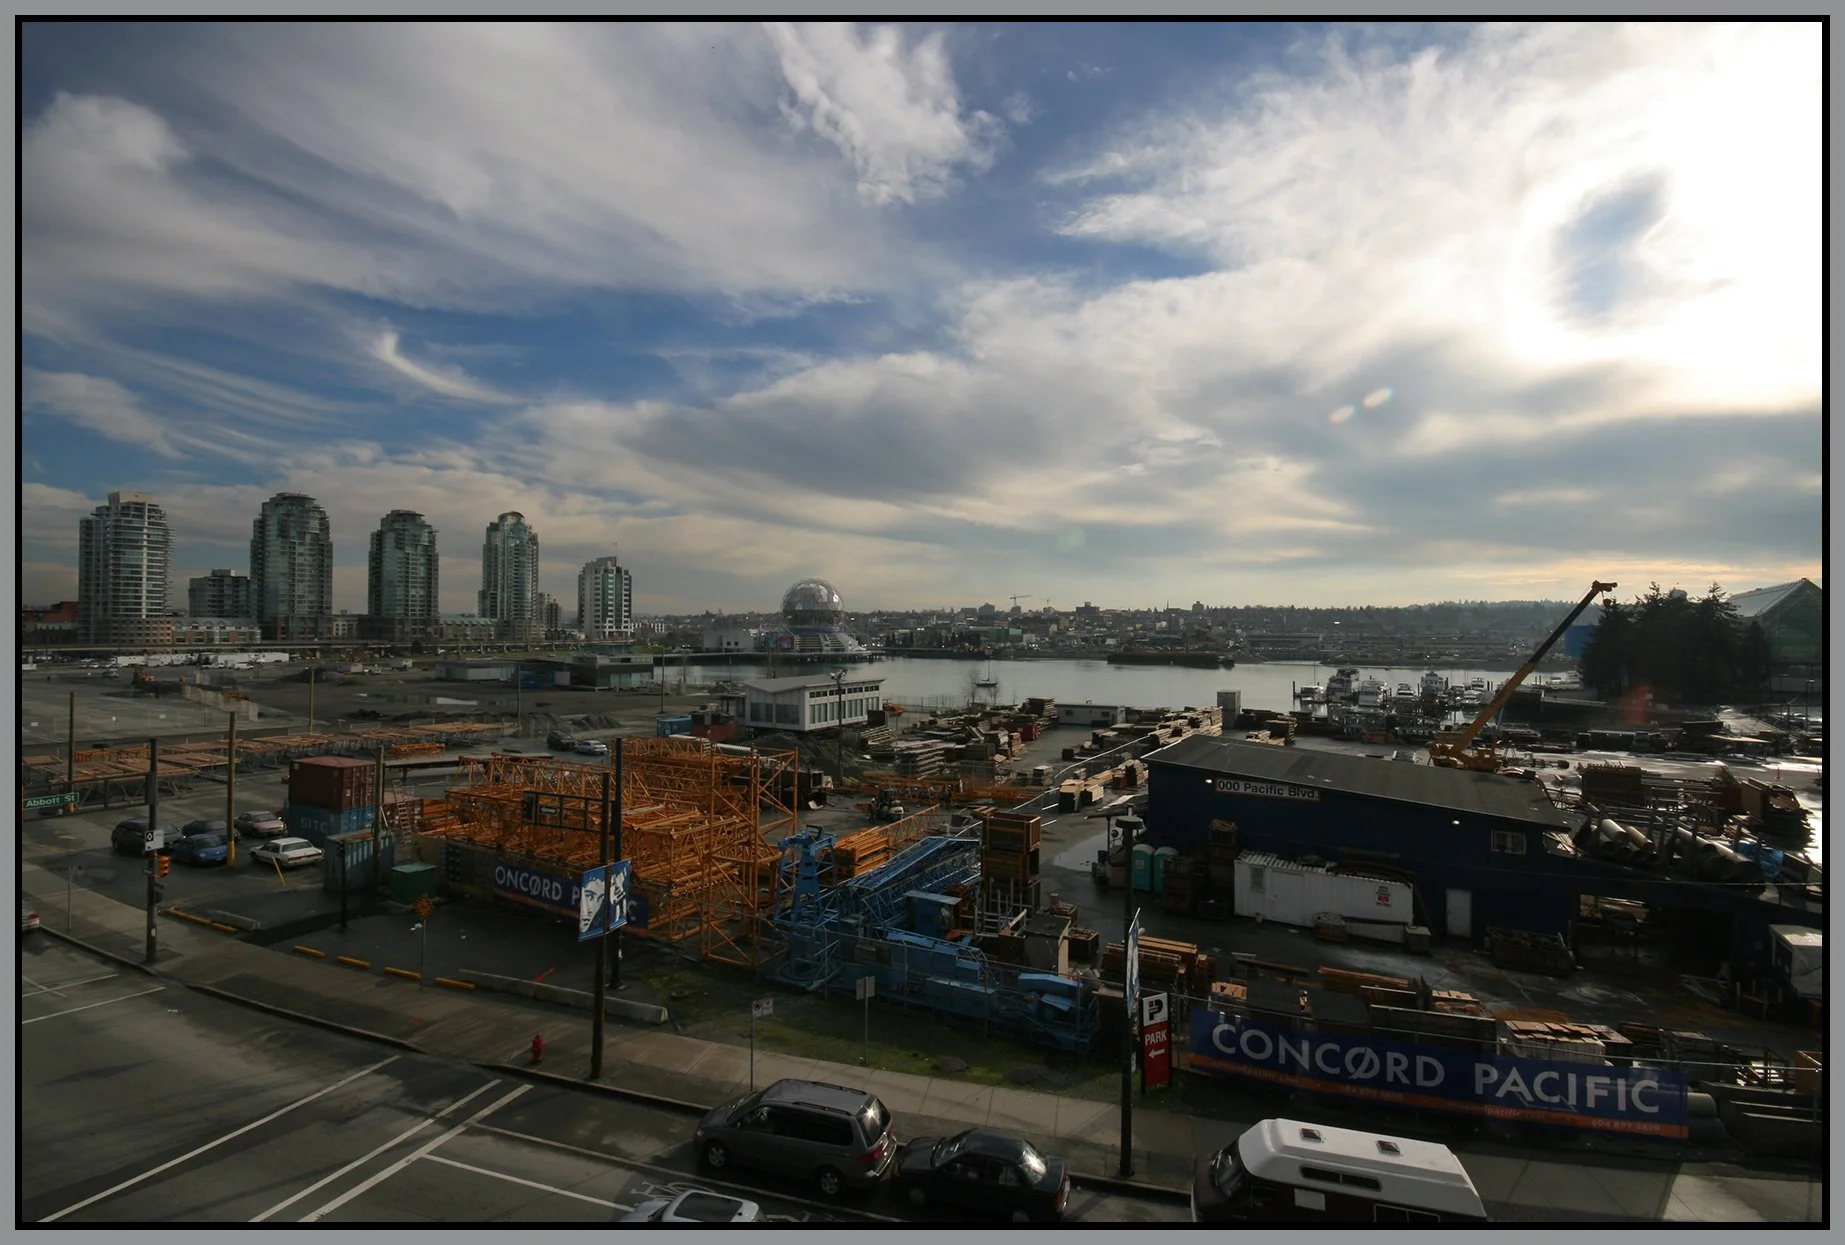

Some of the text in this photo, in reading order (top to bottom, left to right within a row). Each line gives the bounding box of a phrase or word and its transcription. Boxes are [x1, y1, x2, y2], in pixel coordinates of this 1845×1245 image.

[1218, 780, 1240, 791] 000
[1244, 782, 1285, 796] Pacific
[26, 794, 75, 808] Abbott St
[1144, 1029, 1167, 1046] PARK
[1474, 1062, 1659, 1113] PACIFIC
